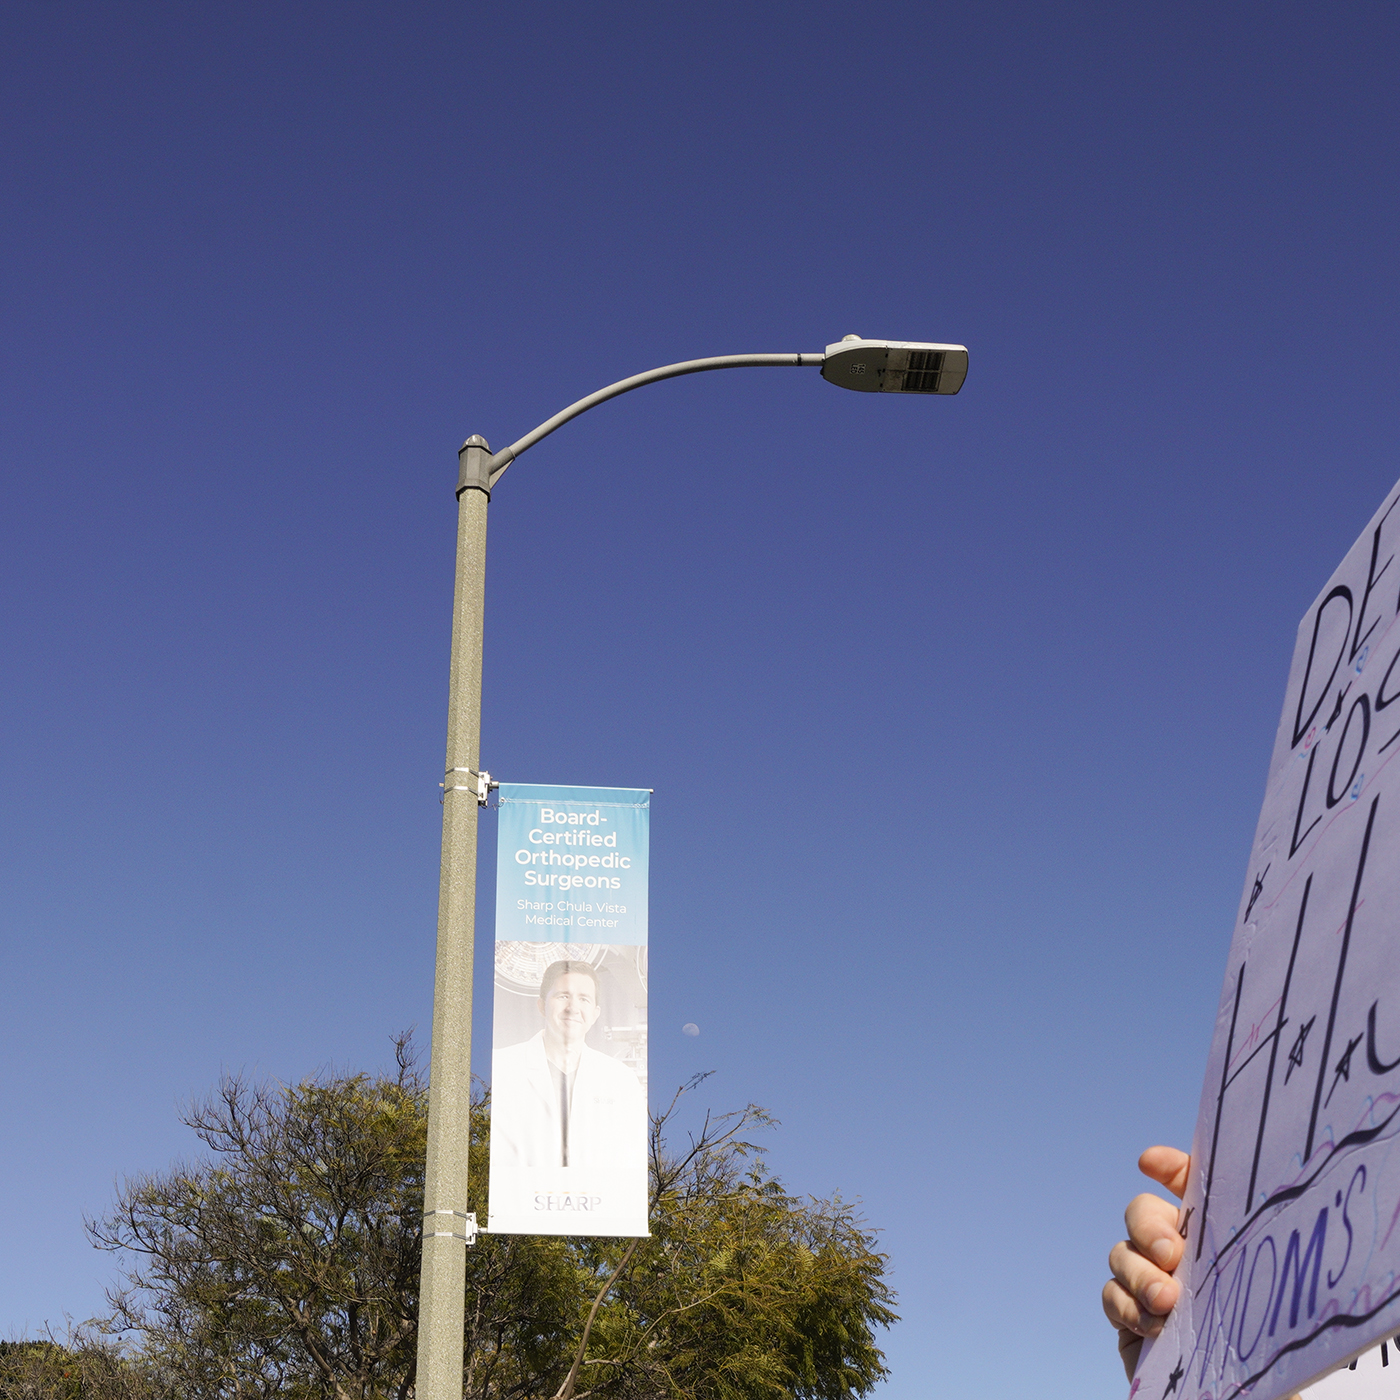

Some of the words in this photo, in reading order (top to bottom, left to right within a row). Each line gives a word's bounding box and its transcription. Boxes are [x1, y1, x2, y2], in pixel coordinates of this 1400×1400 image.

[540, 808, 608, 826] Board-
[528, 829, 617, 849] Certified
[514, 849, 632, 870] Orthopedic
[524, 870, 621, 890] Surgeons
[517, 899, 555, 914] Sharp
[557, 900, 593, 913] Chula
[596, 901, 627, 914] Vista
[525, 913, 574, 926] Medical
[577, 915, 619, 928] Center
[534, 1196, 602, 1211] SHARP
